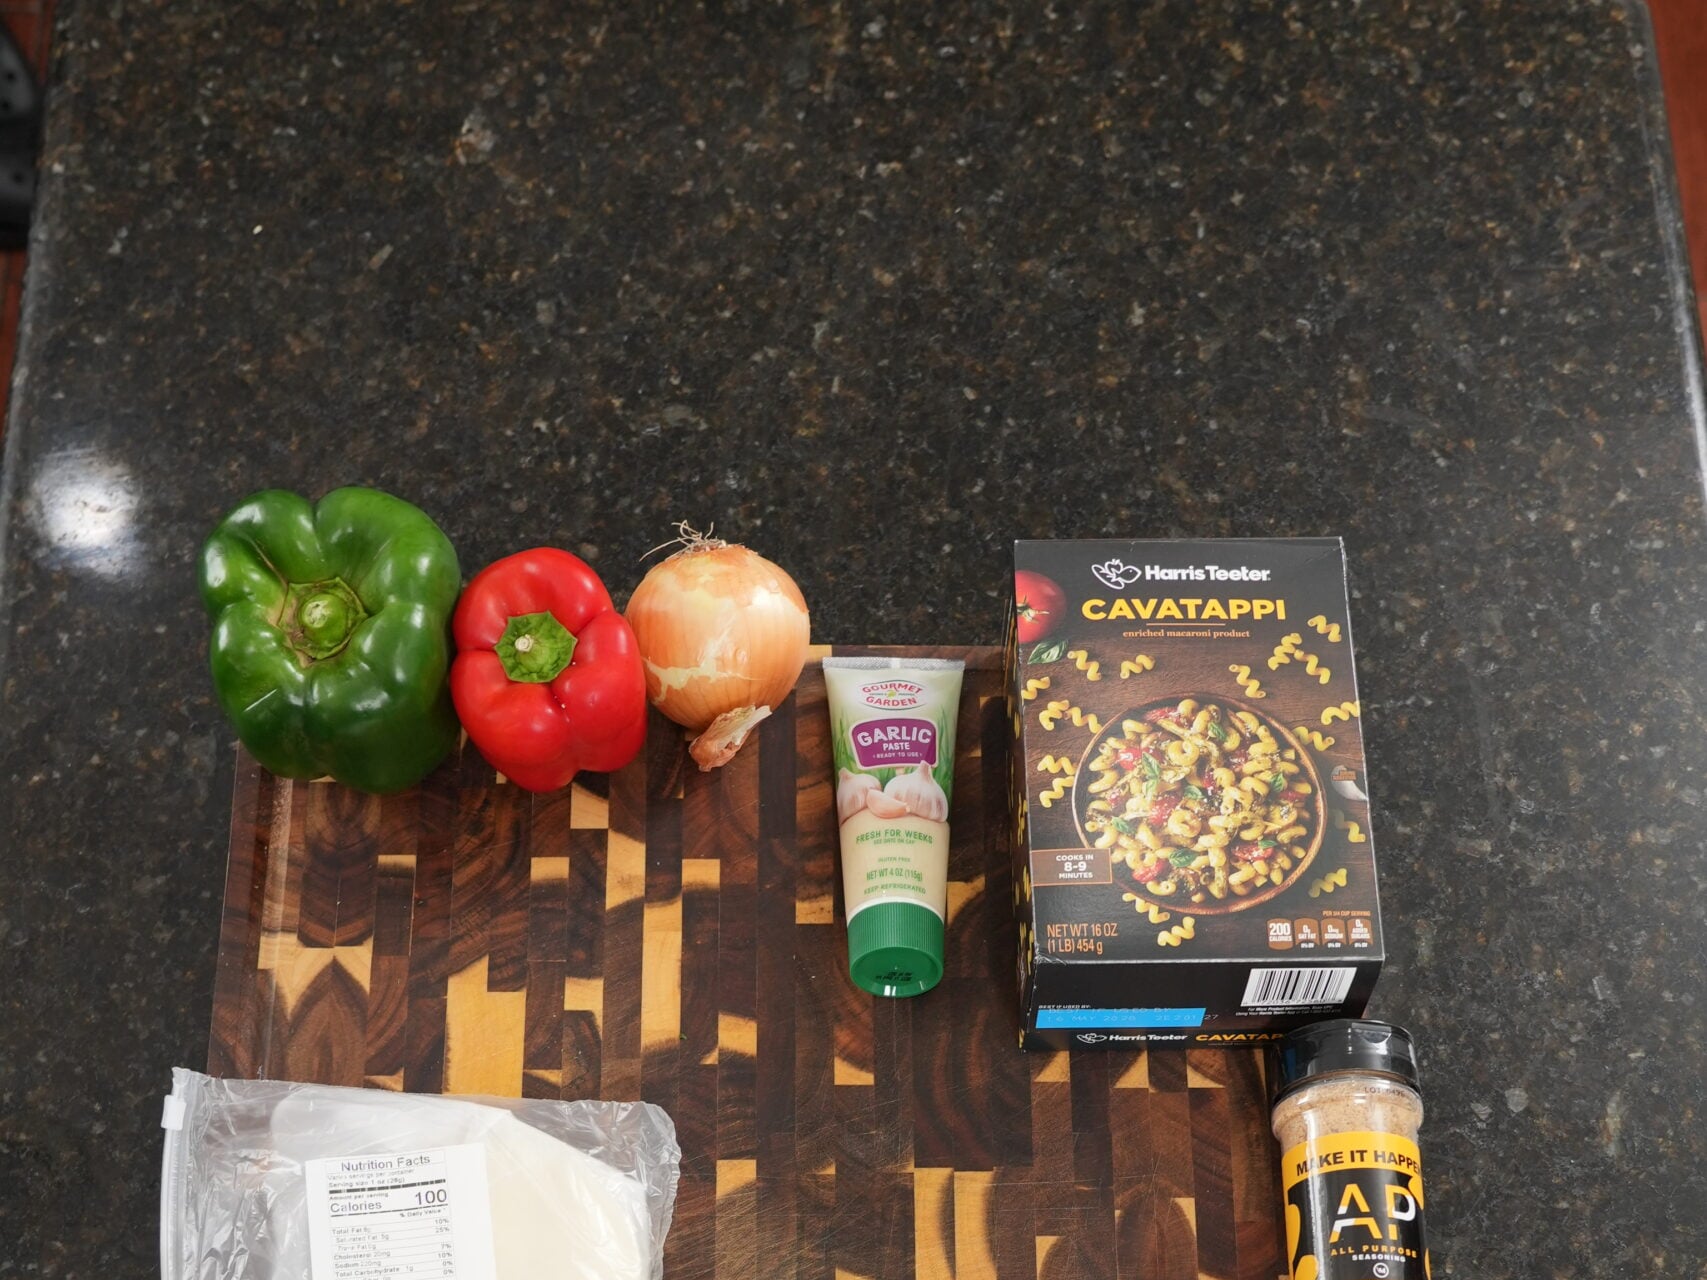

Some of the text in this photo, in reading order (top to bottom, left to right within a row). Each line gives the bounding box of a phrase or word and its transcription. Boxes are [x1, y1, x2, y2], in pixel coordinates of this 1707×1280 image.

[1145, 565, 1271, 581] Harris Teeter
[1081, 598, 1286, 620] CAVATAPPI
[1123, 629, 1250, 639] enriched macaroni product
[862, 682, 923, 694] GOURMET
[866, 696, 917, 707] GARDEN
[857, 726, 932, 747] GARLIC
[883, 742, 911, 751] PASTE
[856, 829, 933, 845] FRESH FOR WEEKS
[1064, 861, 1088, 872] 8-9
[866, 870, 877, 881] NET
[879, 868, 888, 877] WT
[889, 868, 894, 876] 4
[1047, 922, 1119, 938] NET WT 16 OZ
[1269, 923, 1291, 936] 200
[1048, 938, 1103, 955] (1 LB) 454 g
[1195, 1033, 1283, 1041] CAVATAP
[1350, 1149, 1368, 1163] IT
[341, 1155, 431, 1172] Nutrition Facts
[330, 1188, 448, 1214] Calories 100
[1331, 1245, 1418, 1259] ALL PURPOSE
[1352, 1253, 1406, 1263] SEASONING
